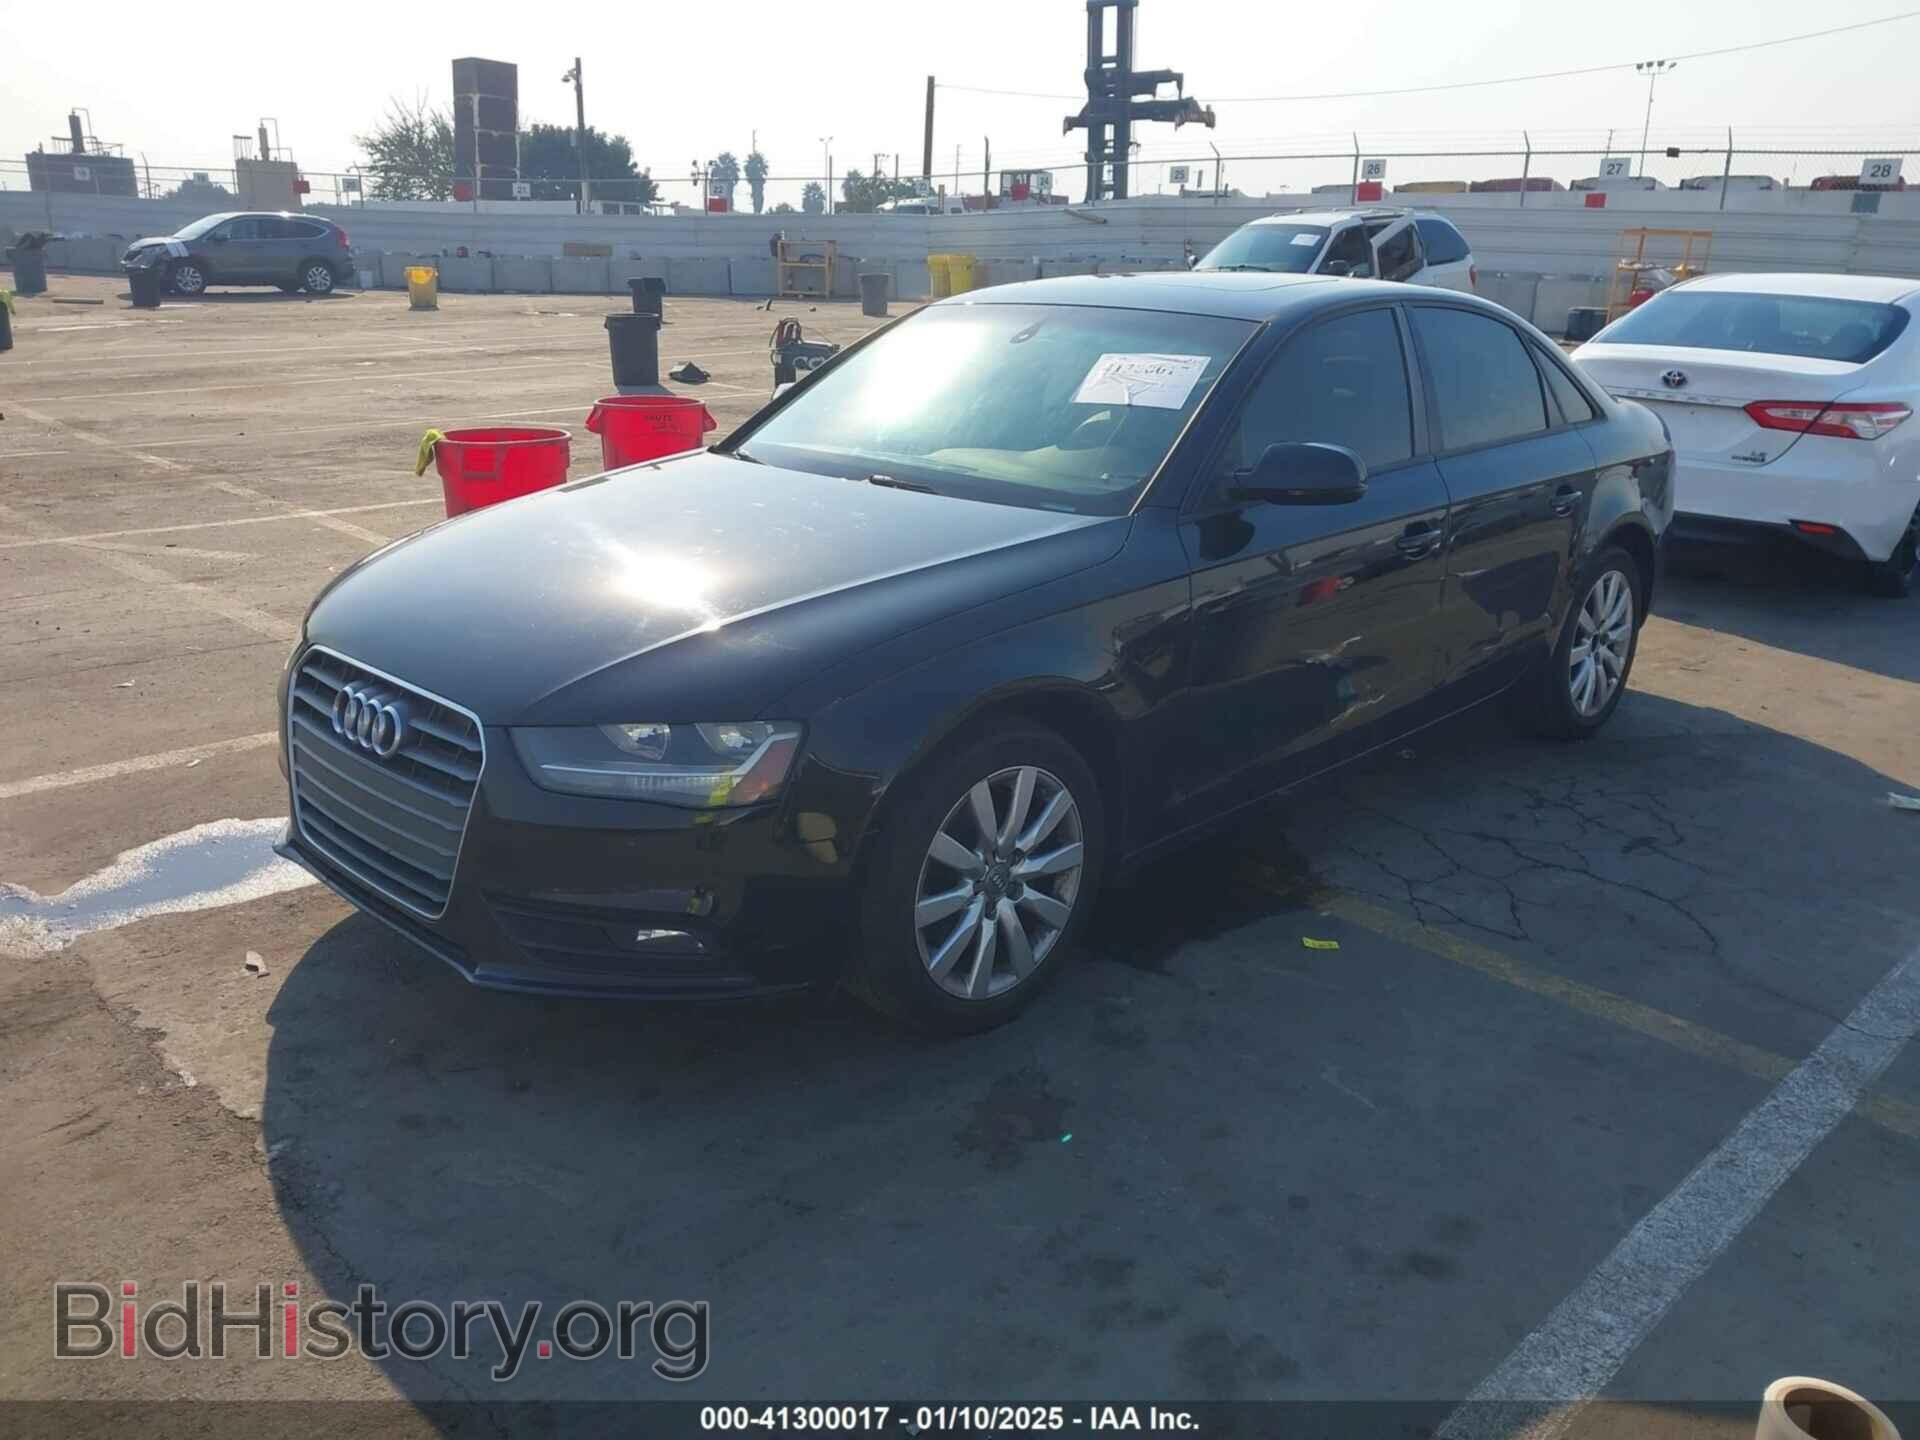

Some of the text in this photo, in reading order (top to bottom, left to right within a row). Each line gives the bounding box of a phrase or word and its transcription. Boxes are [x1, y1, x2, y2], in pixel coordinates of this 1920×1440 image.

[1367, 163, 1381, 175] 26
[1606, 163, 1624, 175] 27
[1871, 164, 1892, 177] 28
